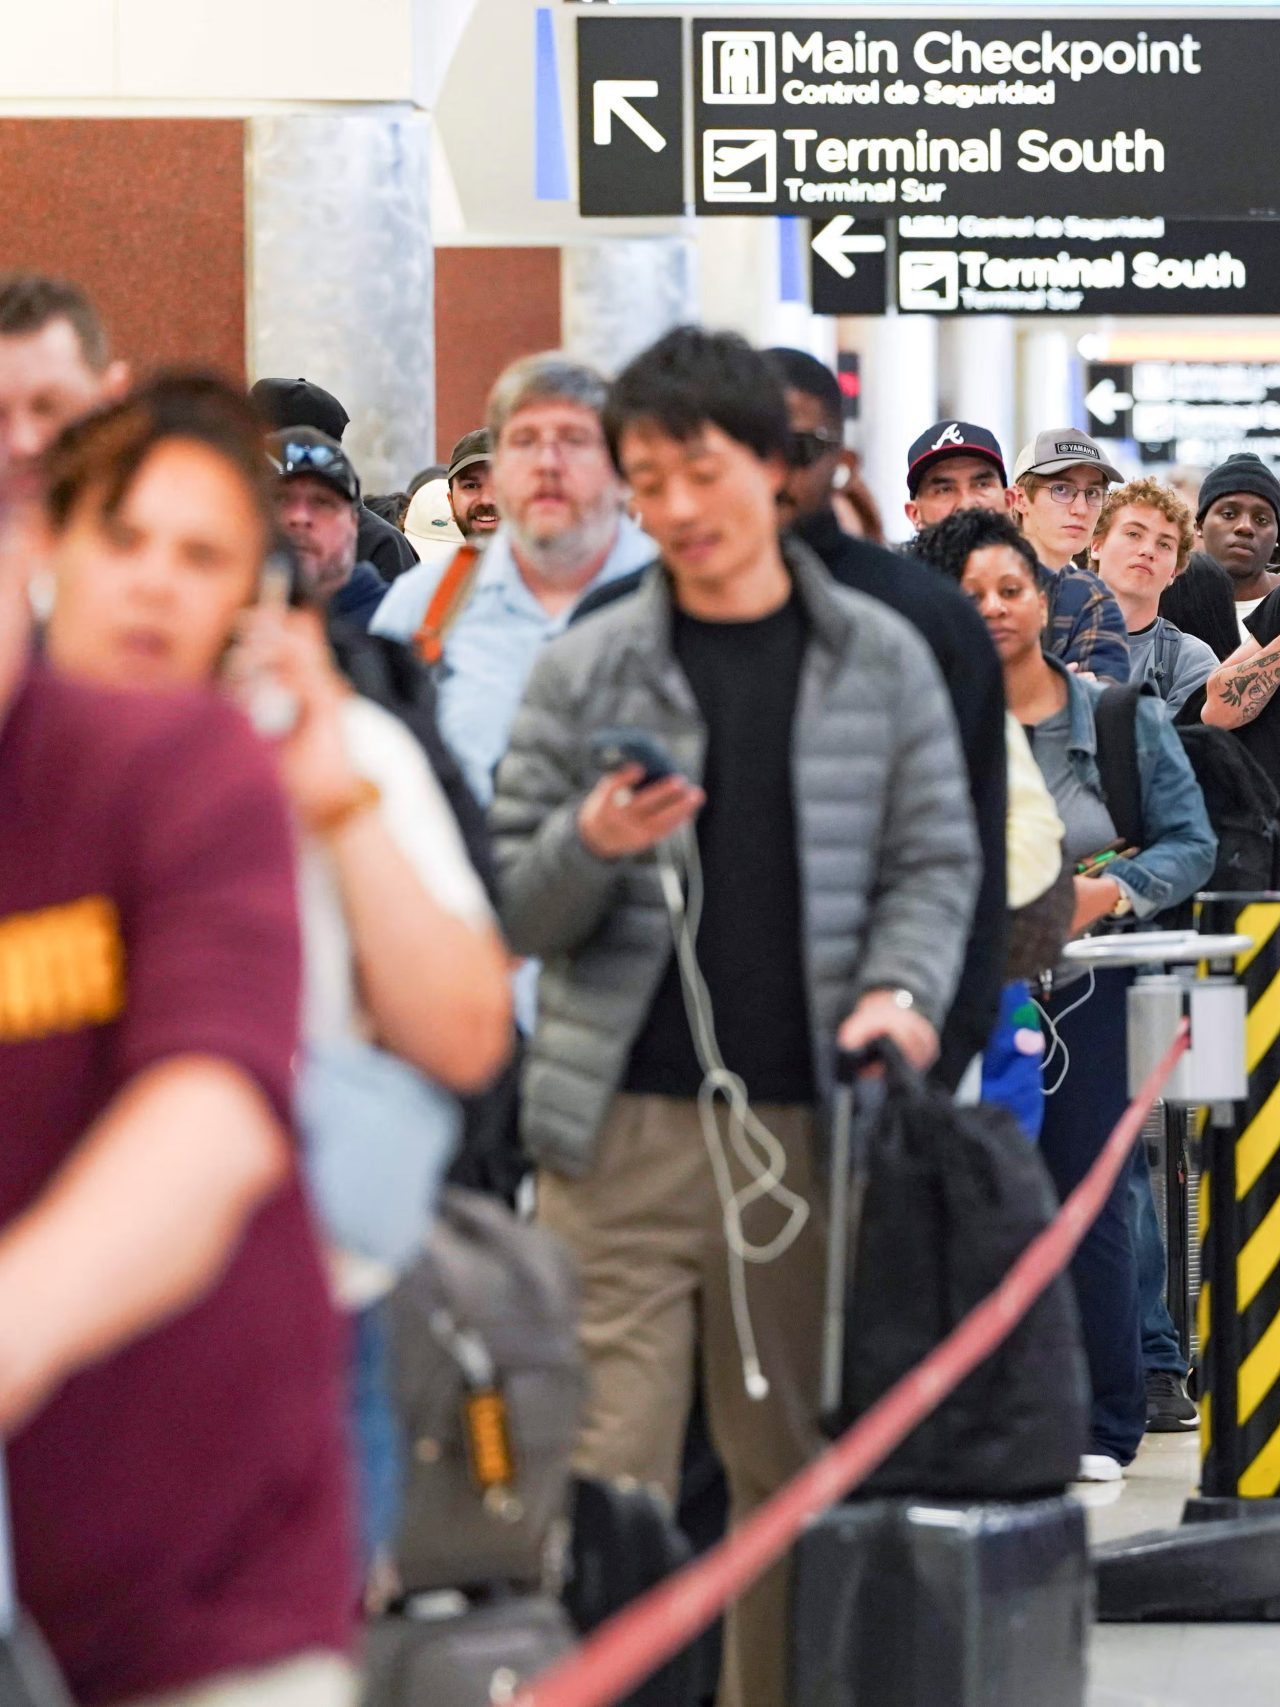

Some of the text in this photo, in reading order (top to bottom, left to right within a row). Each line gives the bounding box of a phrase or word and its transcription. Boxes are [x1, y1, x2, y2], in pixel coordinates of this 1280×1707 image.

[781, 29, 1202, 80] Main Checkpoint
[782, 79, 1056, 108] Control de Seguridad
[782, 127, 1165, 173] Terminal South
[783, 177, 947, 203] Terminal Sur
[958, 250, 1246, 289] Terminal South
[930, 423, 965, 451] A
[1068, 444, 1096, 456] YAMAHA
